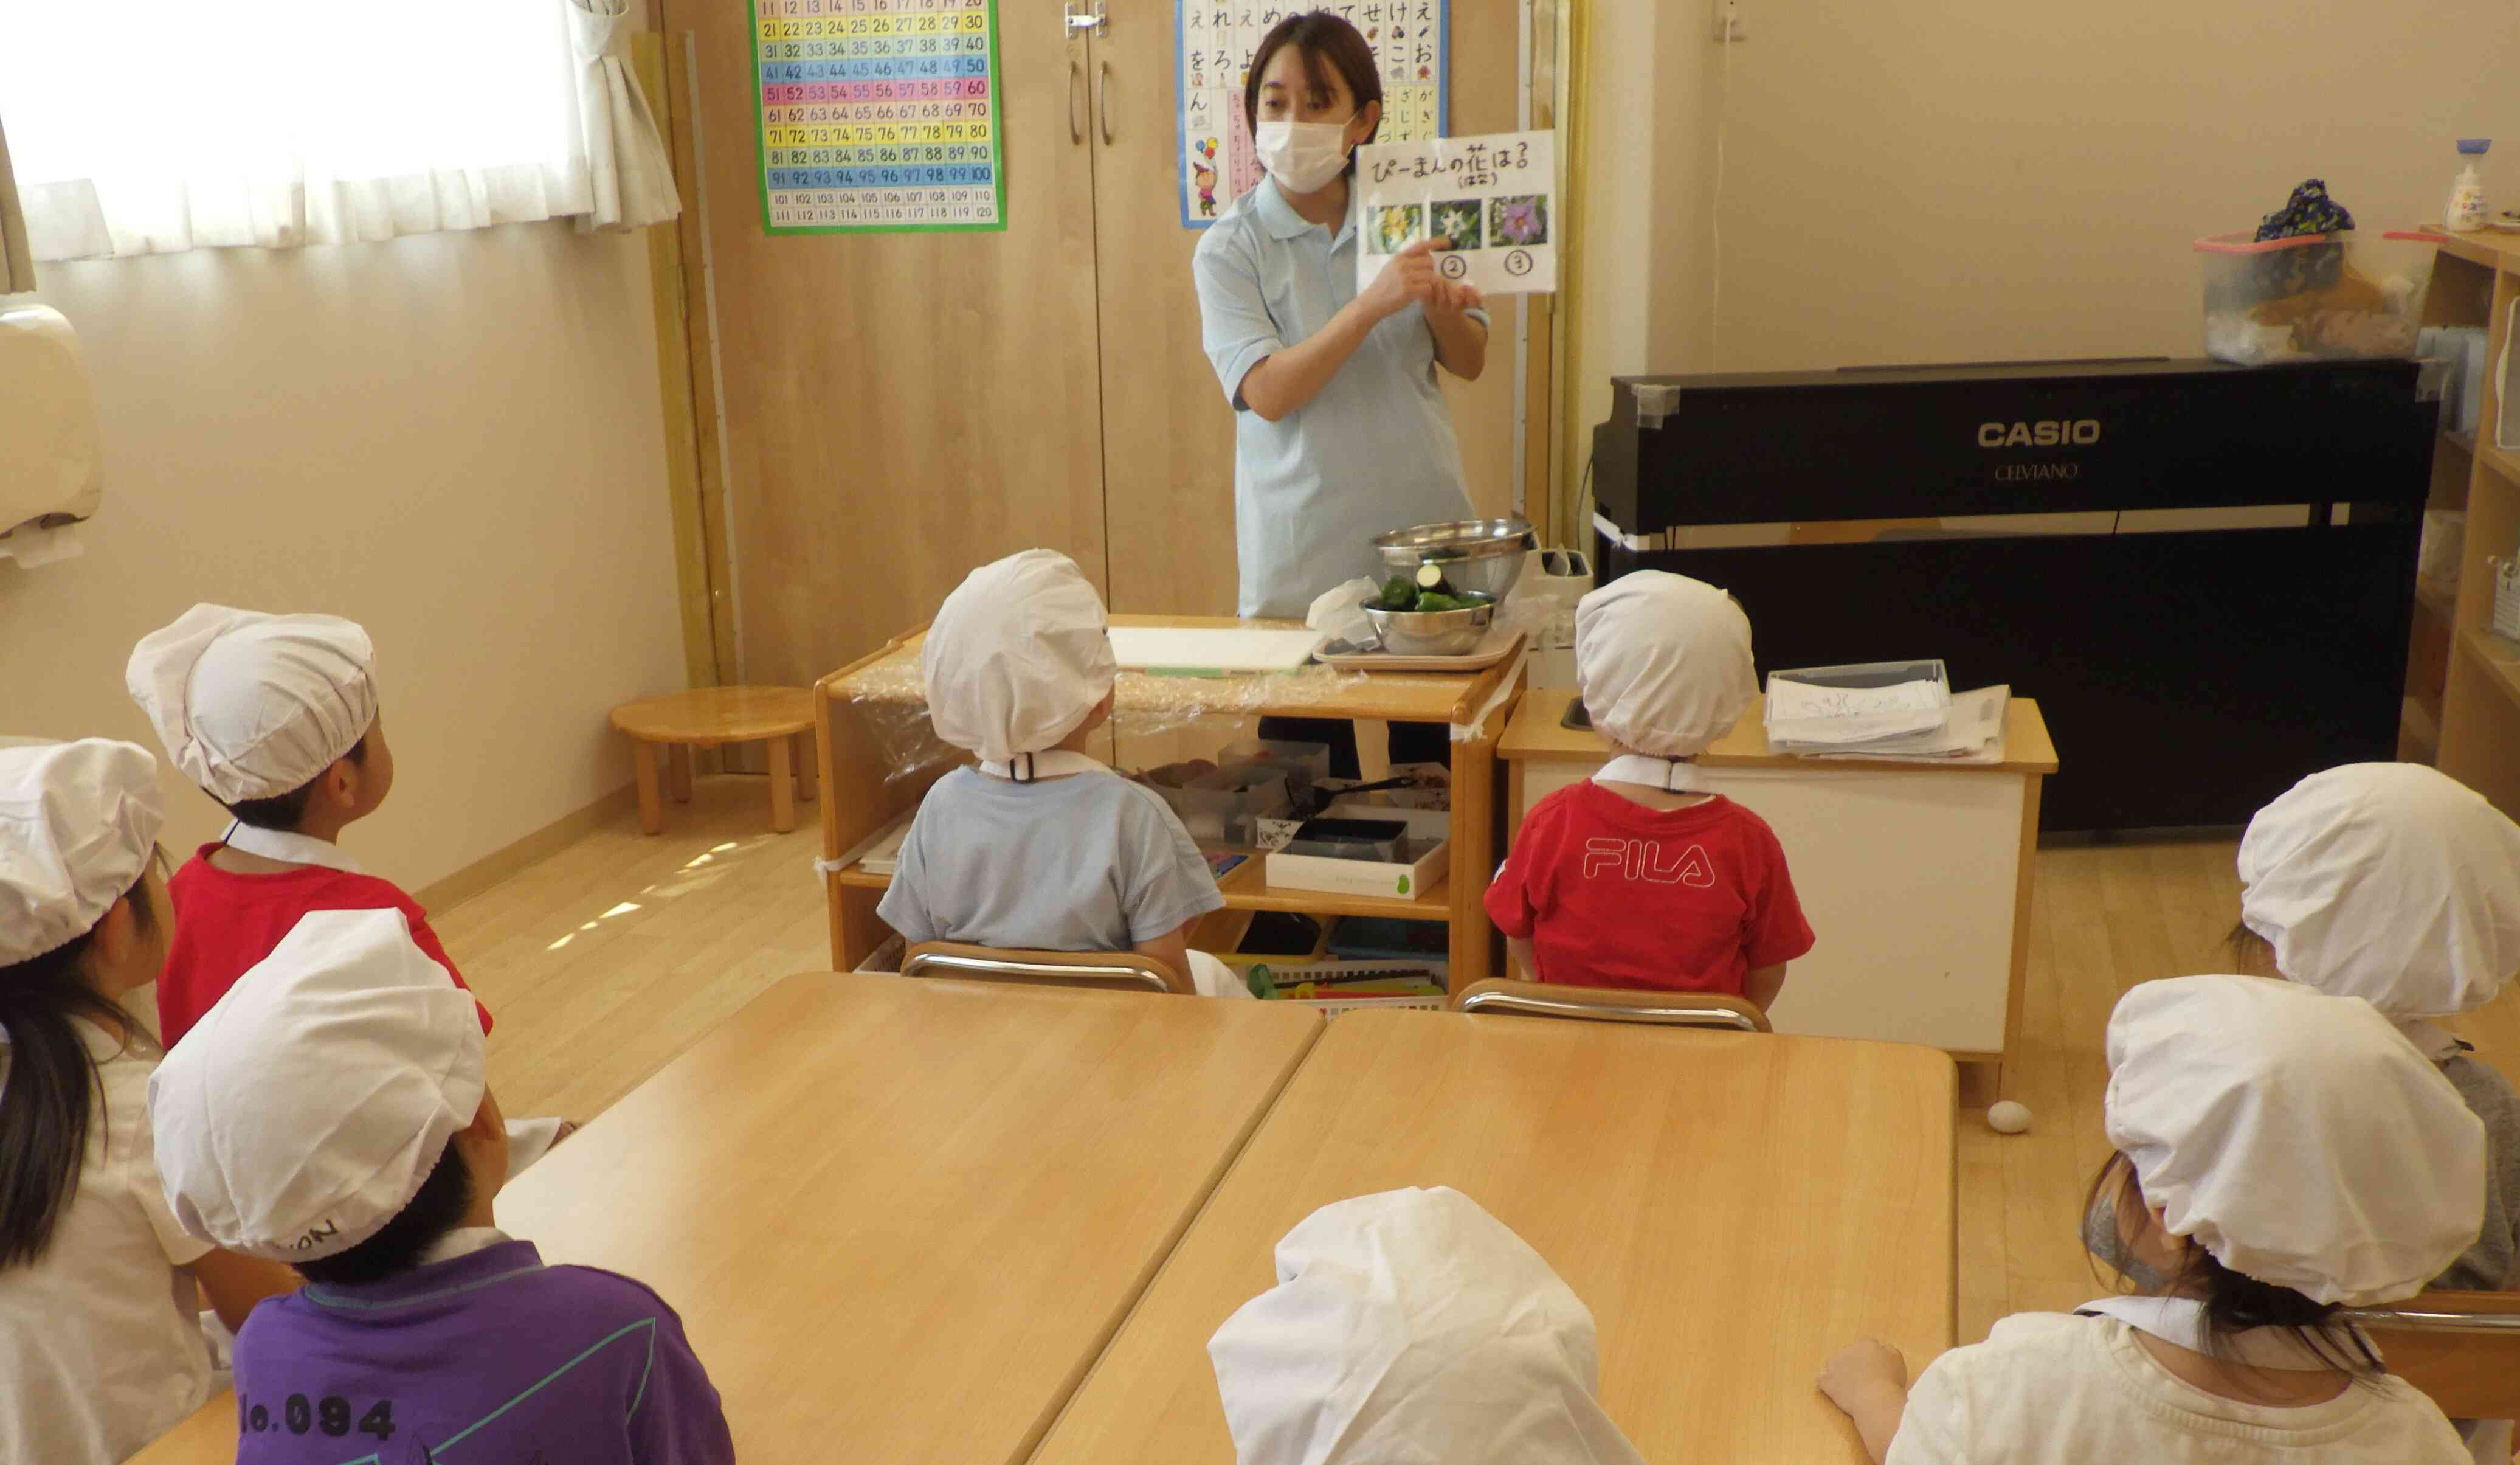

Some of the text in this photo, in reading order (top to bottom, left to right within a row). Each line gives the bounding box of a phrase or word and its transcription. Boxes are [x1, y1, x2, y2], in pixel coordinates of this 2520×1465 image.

[763, 2, 773, 15] 11
[785, 1, 797, 14] 12
[807, 0, 820, 13] 13
[830, 0, 842, 12] 14
[852, 0, 865, 11] 15
[875, 0, 887, 10] 16
[897, 0, 909, 10] 17
[1213, 9, 1231, 28] れ
[1263, 7, 1281, 24] め
[1363, 4, 1381, 22] せ
[1390, 2, 1407, 22] け
[1417, 2, 1432, 20] え
[764, 15, 982, 37] 21 22 23 24 25 26 27 28 29 30
[766, 37, 983, 58] 31 32 33 34 35 36 37 38 39 40
[1190, 50, 1204, 71] を
[1215, 50, 1231, 69] ろ
[1240, 49, 1253, 69] よ
[1392, 46, 1405, 62] こ
[1415, 43, 1431, 63] お
[766, 59, 984, 79] 41 42 43 44 45 46 47 48 49 50
[767, 81, 985, 101] 51 52 53 54 55 56 57 58 59 60
[1190, 92, 1207, 111] ん
[1420, 89, 1433, 102] が
[768, 103, 986, 122] 61 62 63 64 65 66 67 68 69 70
[770, 125, 986, 144] 71 72 73 74 75 76 77 78 79 80
[772, 146, 987, 164] 81 82 83 84 85 86 87 88 89 90
[772, 168, 990, 185] 91 92 93 94 95 96 97 98 99 100
[775, 190, 990, 204] 101 102 103 104 105 106 107 108 109 110
[777, 207, 992, 221] 111 112 113 114 115 116 117 118 119 120
[1978, 420, 2101, 447] CASIO
[1995, 463, 2079, 482] CELVIANO
[1583, 837, 1715, 888] FILA
